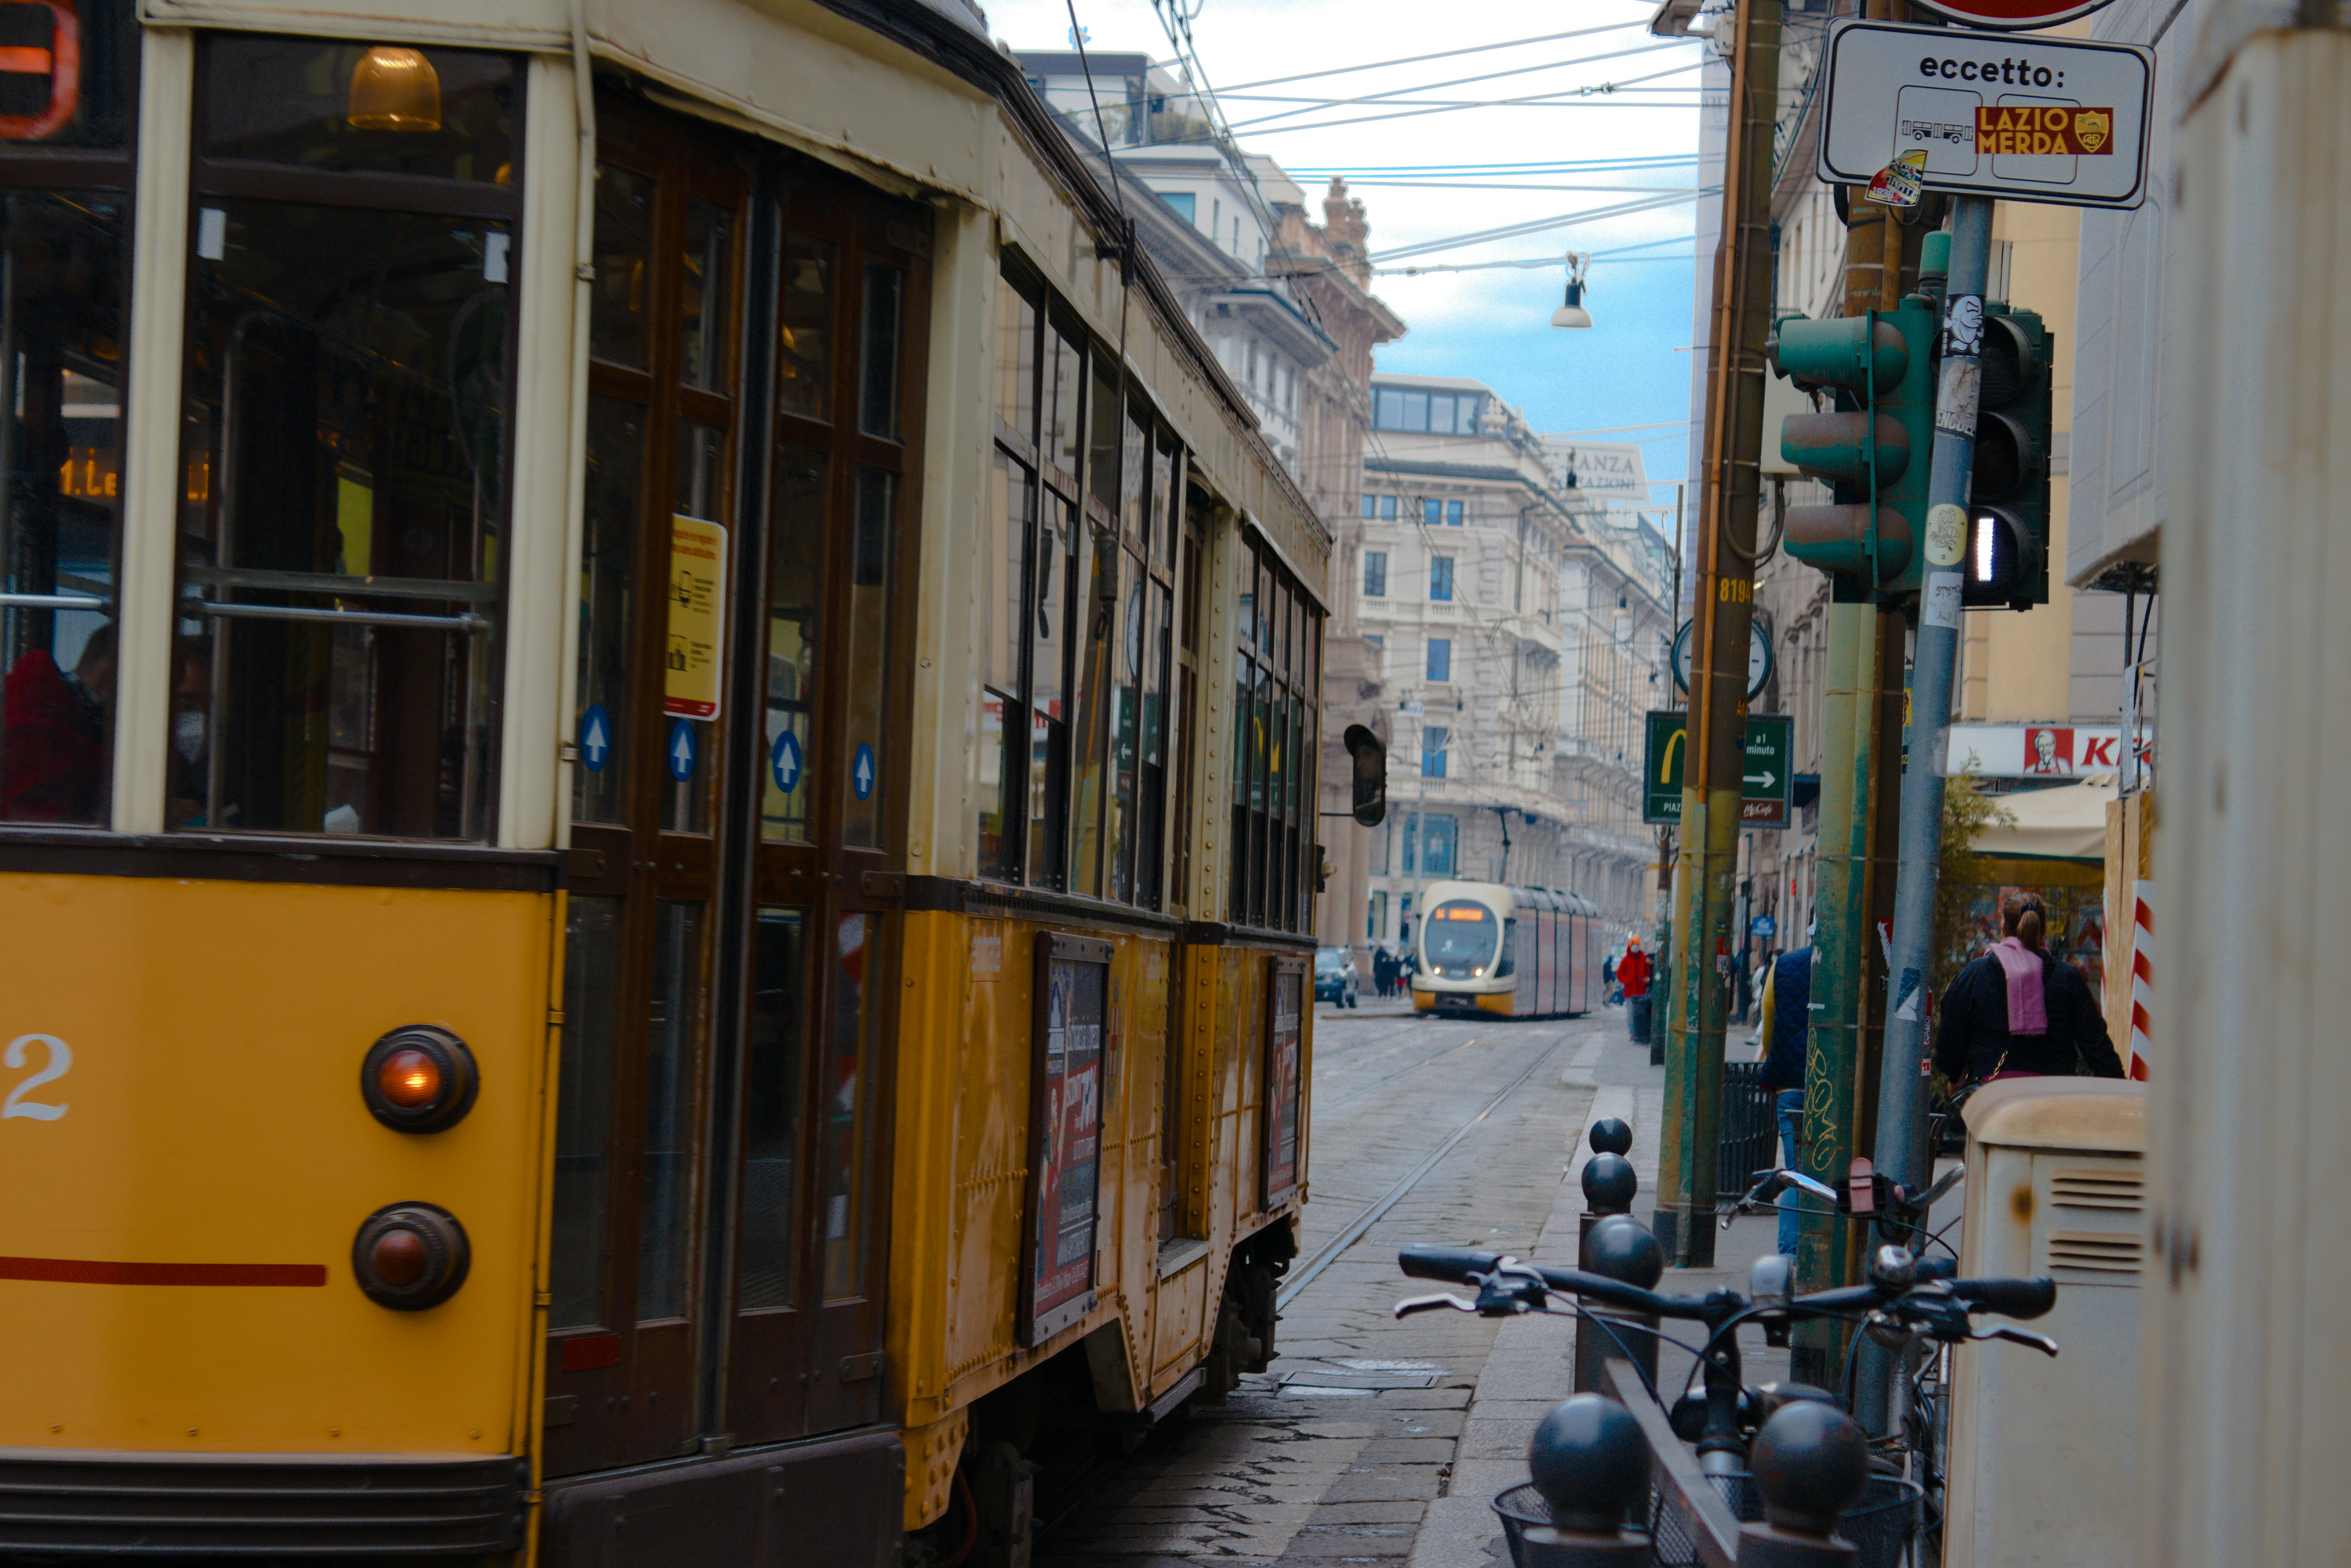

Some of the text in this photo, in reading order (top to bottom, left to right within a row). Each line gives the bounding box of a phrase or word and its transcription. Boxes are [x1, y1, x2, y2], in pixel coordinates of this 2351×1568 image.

[1920, 57, 2065, 88] eccetto:
[1981, 108, 2069, 131] LAZIO
[1978, 132, 2069, 154] MERDA
[1872, 186, 1894, 199] 1936
[1720, 577, 1752, 604] 8194
[1746, 745, 1775, 755] minuto
[1756, 735, 1761, 744] a
[1663, 802, 1681, 813] PIAZ
[2, 1033, 73, 1121] 2
